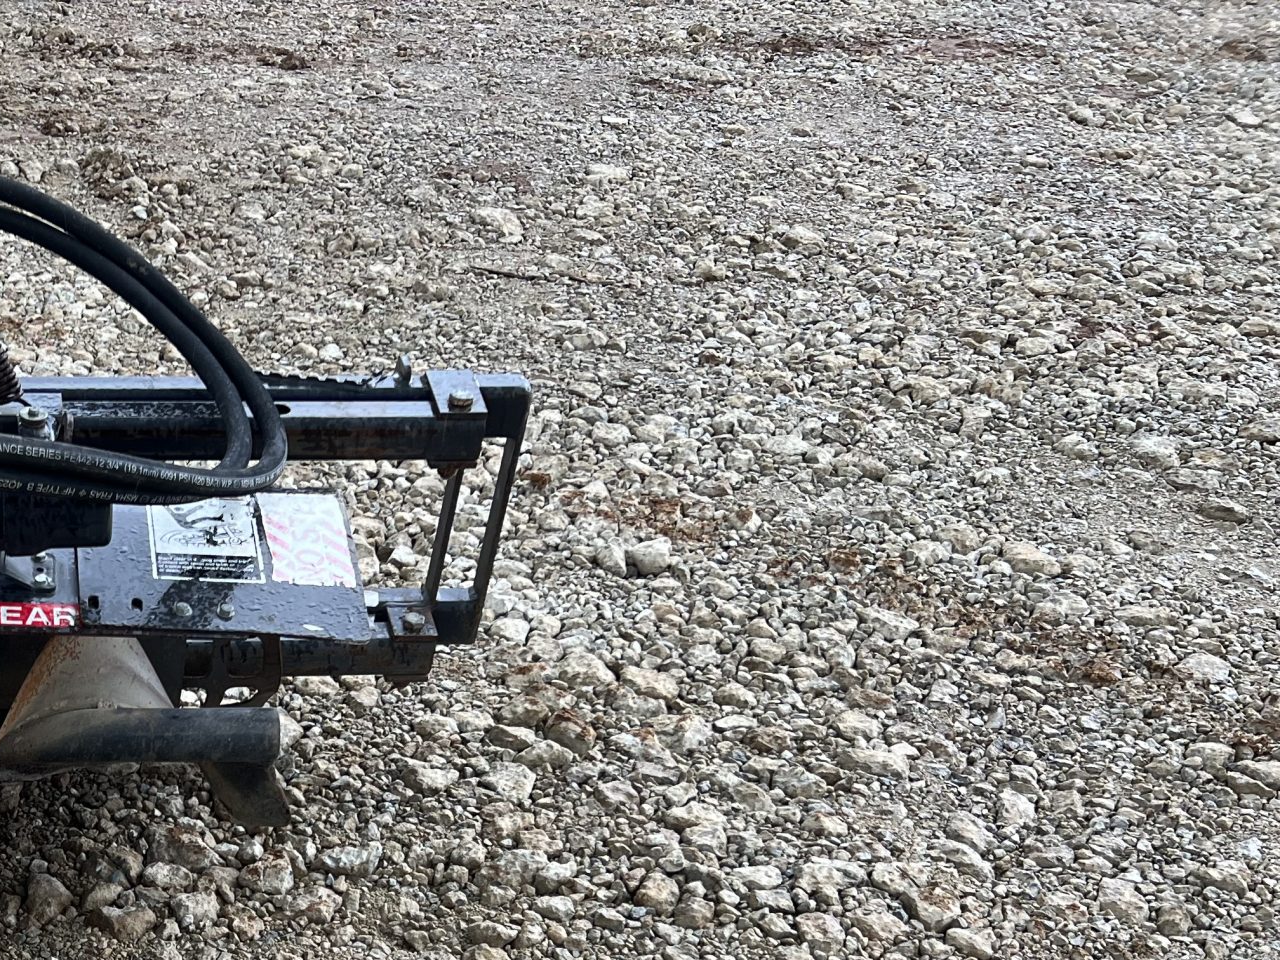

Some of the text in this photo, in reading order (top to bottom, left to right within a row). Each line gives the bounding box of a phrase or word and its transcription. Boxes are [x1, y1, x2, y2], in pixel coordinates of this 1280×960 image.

[25, 445, 61, 461] SERIES
[160, 468, 177, 481] 6091
[26, 482, 35, 491] B
[35, 483, 60, 495] TYPE
[61, 487, 76, 496] HF
[88, 489, 113, 500] FRAS
